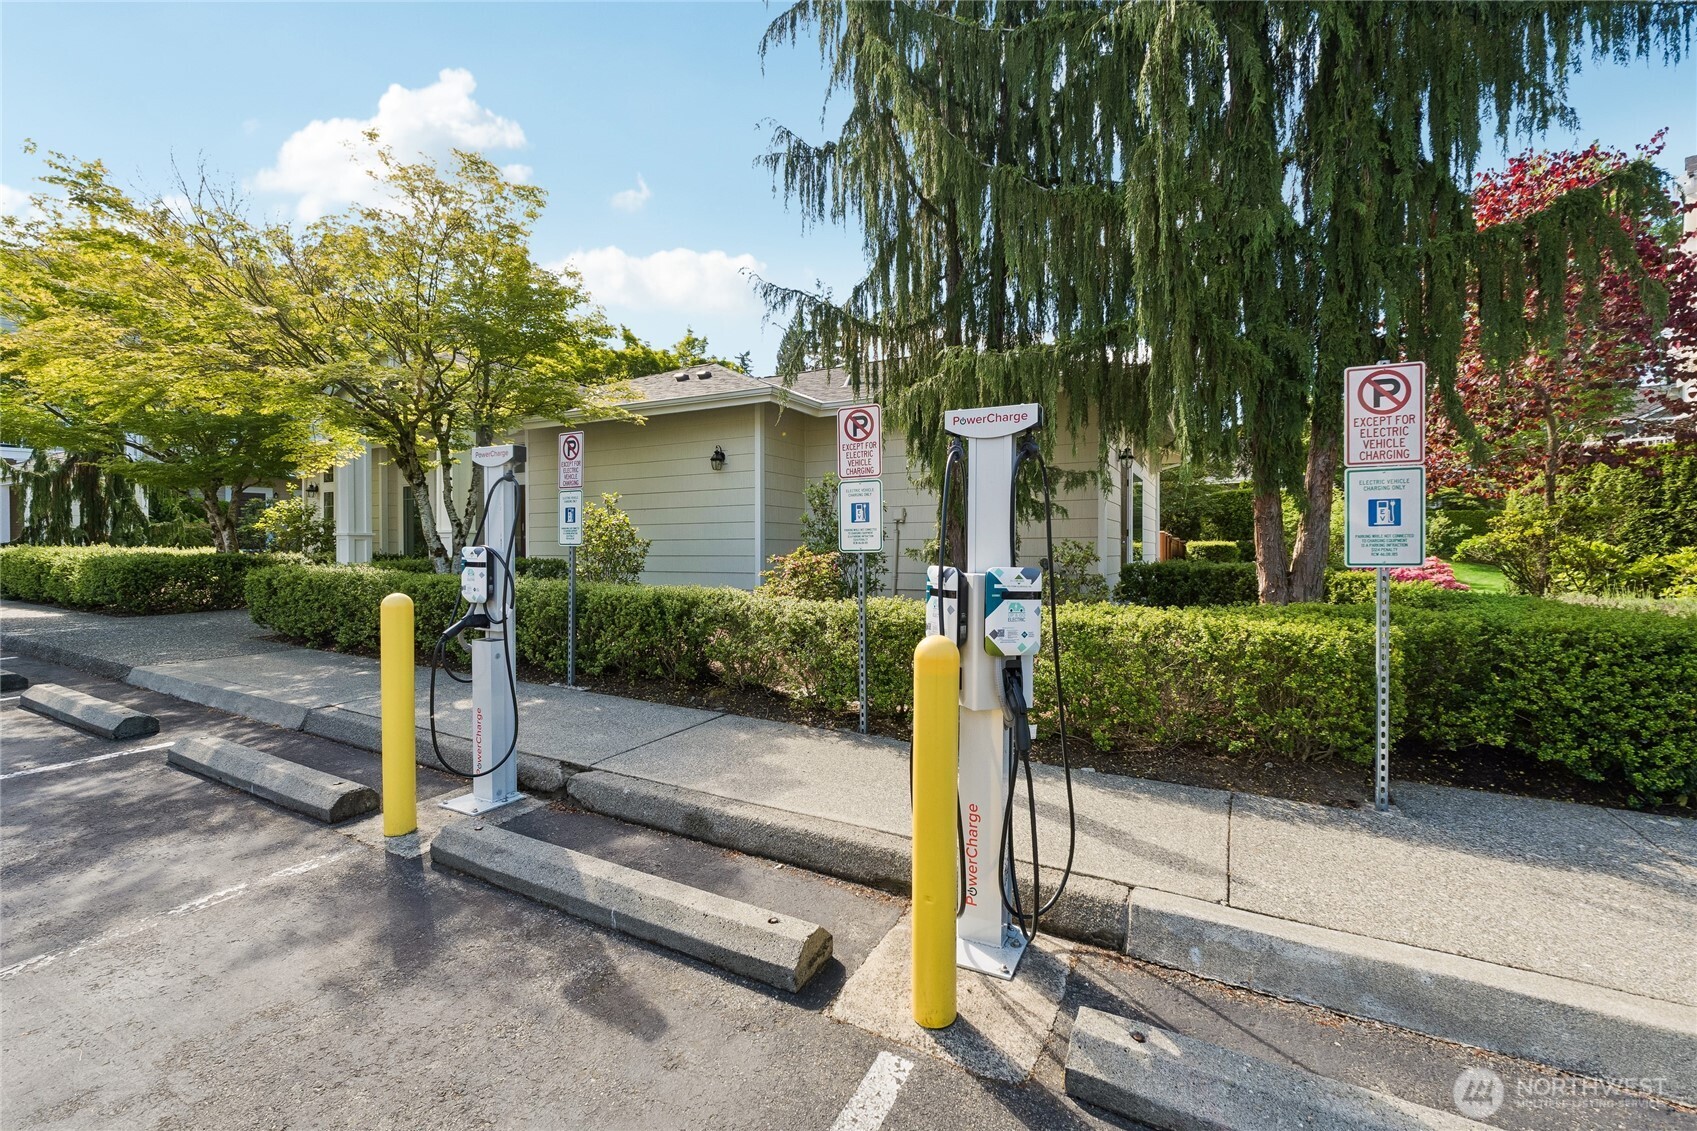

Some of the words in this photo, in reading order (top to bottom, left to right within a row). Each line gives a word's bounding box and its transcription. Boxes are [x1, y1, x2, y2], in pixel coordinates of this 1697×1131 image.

[953, 412, 1028, 425] PowerCharge
[1354, 416, 1392, 427] EXCEPT
[1396, 414, 1416, 424] FOR
[1360, 426, 1409, 438] ELECTRIC
[842, 442, 863, 451] EXCEPT
[1363, 438, 1406, 449] VEHICLE
[846, 450, 873, 459] ELECTRIC
[1360, 449, 1410, 460] CHARGING
[848, 458, 872, 467] VEHICLE
[846, 467, 874, 475] CHARGING
[966, 804, 981, 906] PowerCharge
